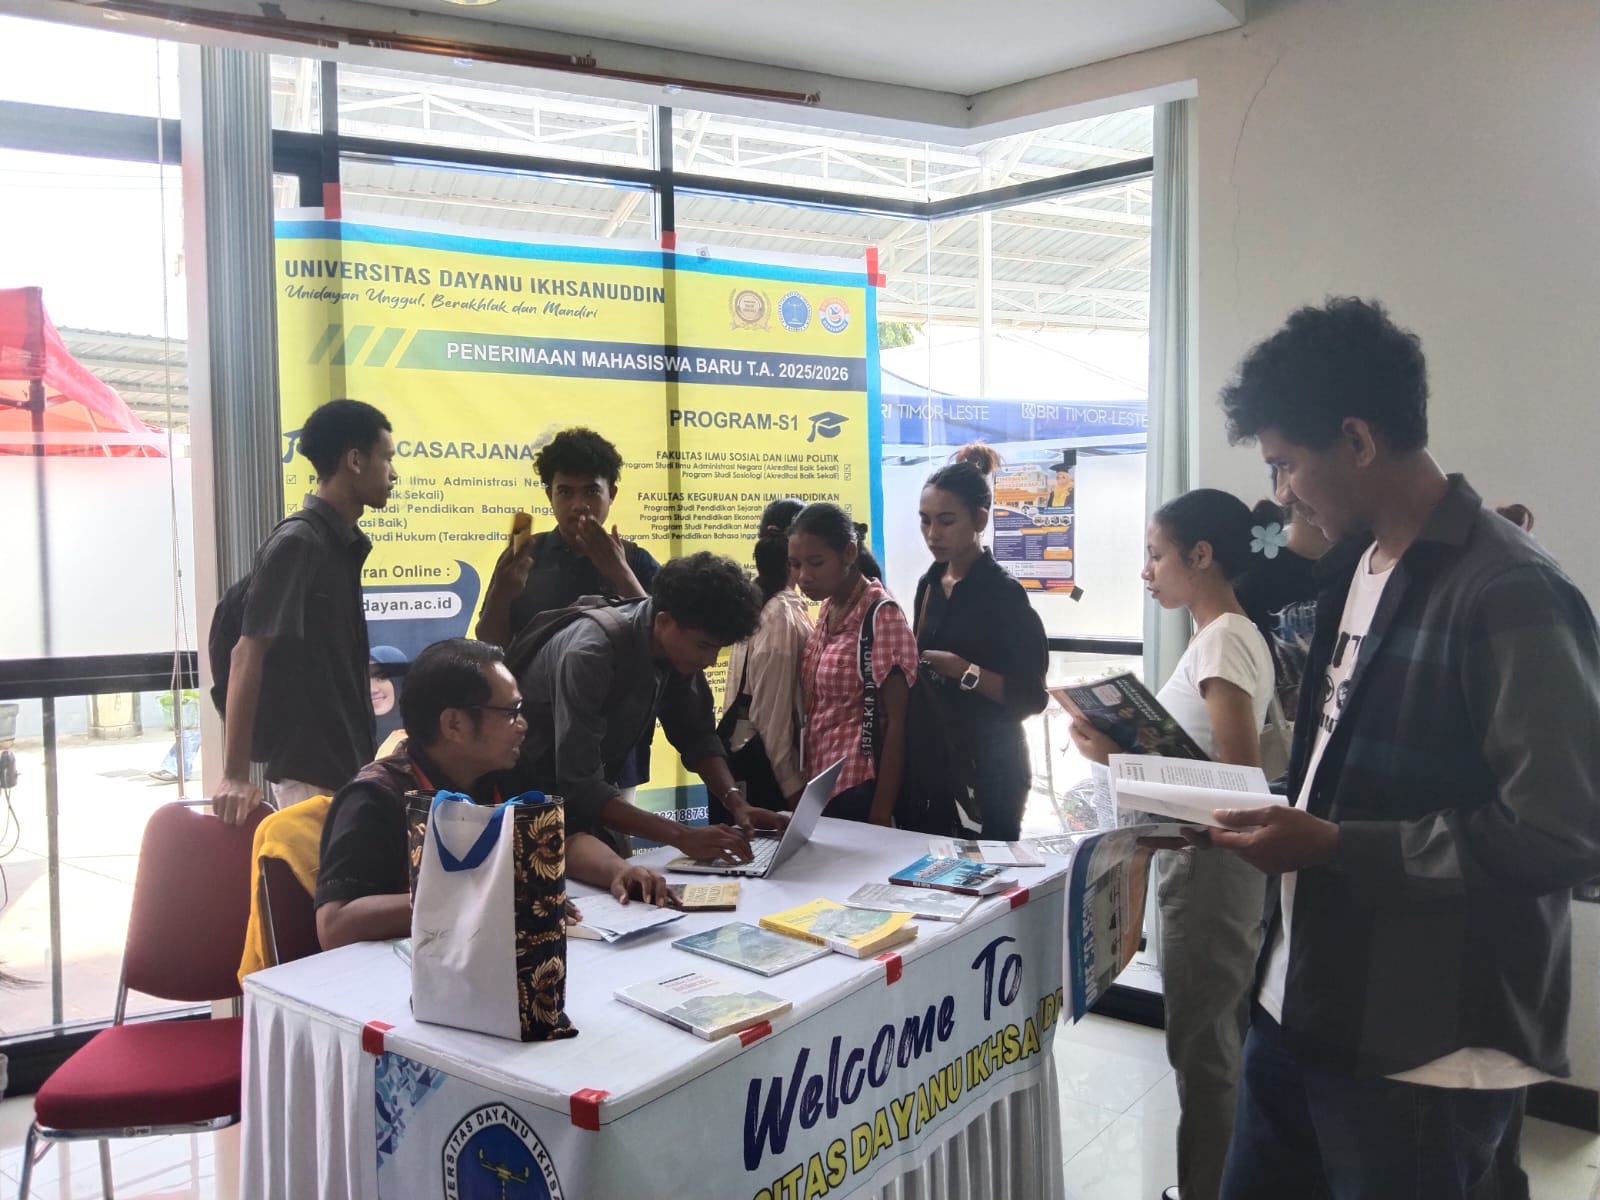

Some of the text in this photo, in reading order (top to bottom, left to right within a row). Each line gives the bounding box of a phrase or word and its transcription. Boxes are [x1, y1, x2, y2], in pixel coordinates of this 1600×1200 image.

[285, 259, 665, 304] UNIVERSITAS DAYANU IKHSANUDDIN
[284, 284, 359, 305] Unidayan
[431, 293, 510, 314] Berakhlak
[511, 300, 537, 315] dan
[542, 300, 598, 319] Mandiri
[446, 342, 850, 382] PENERIMAAN MAHASISWA BARU T.A. 2025/2026
[881, 403, 990, 421] RI TIMOR-LESTE
[1037, 404, 1149, 428] BRI TIMOR-LESTE
[669, 409, 799, 432] PROGRAM-S1
[396, 440, 535, 461] CASARJANA
[656, 450, 839, 463] FAKULTAS ILMU SOSIAL DAN ILMU POLITIK
[409, 475, 437, 486] Ilmu
[443, 475, 517, 488] Administrasi
[523, 478, 549, 490] Neg
[404, 489, 444, 502] Sekali)
[637, 492, 840, 502] FAKULTAS KEGURUAN DAN ILMU PENDIDIKAN
[407, 503, 475, 515] Pendidikan
[531, 505, 555, 516] Ingg
[696, 504, 736, 512] Pendidikan
[378, 518, 407, 530] Baik)
[693, 513, 732, 521] Pendidikan
[733, 513, 761, 521] Ekonom
[396, 531, 436, 542] Hukum
[439, 531, 513, 543] (Terakredita
[671, 532, 712, 541] Pendidikan
[740, 532, 761, 541] Inggr
[392, 564, 442, 579] Online
[363, 596, 453, 615] dayan.ac.id
[743, 995, 955, 1171] Welcome
[971, 935, 1023, 1021] To
[476, 1107, 529, 1139] DAYANU
[851, 1057, 963, 1174] DAYANU
